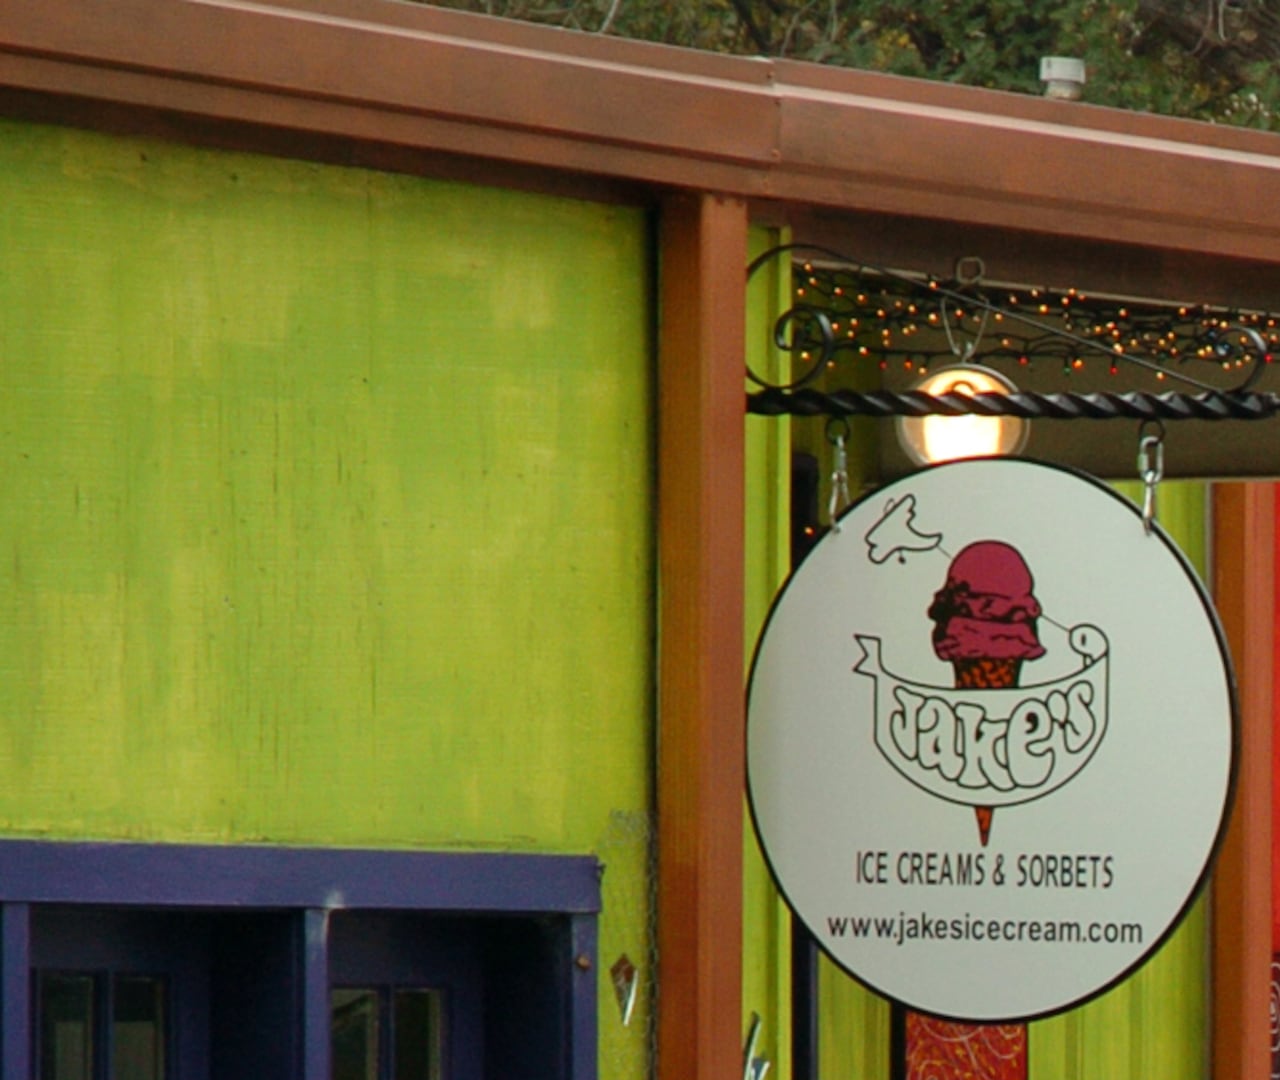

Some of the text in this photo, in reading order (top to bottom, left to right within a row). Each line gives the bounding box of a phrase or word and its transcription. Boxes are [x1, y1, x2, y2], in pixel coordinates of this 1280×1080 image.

[856, 850, 1115, 889] ICE CREAMS & SORBETS
[827, 911, 1144, 946] www.jakesicecream.com
